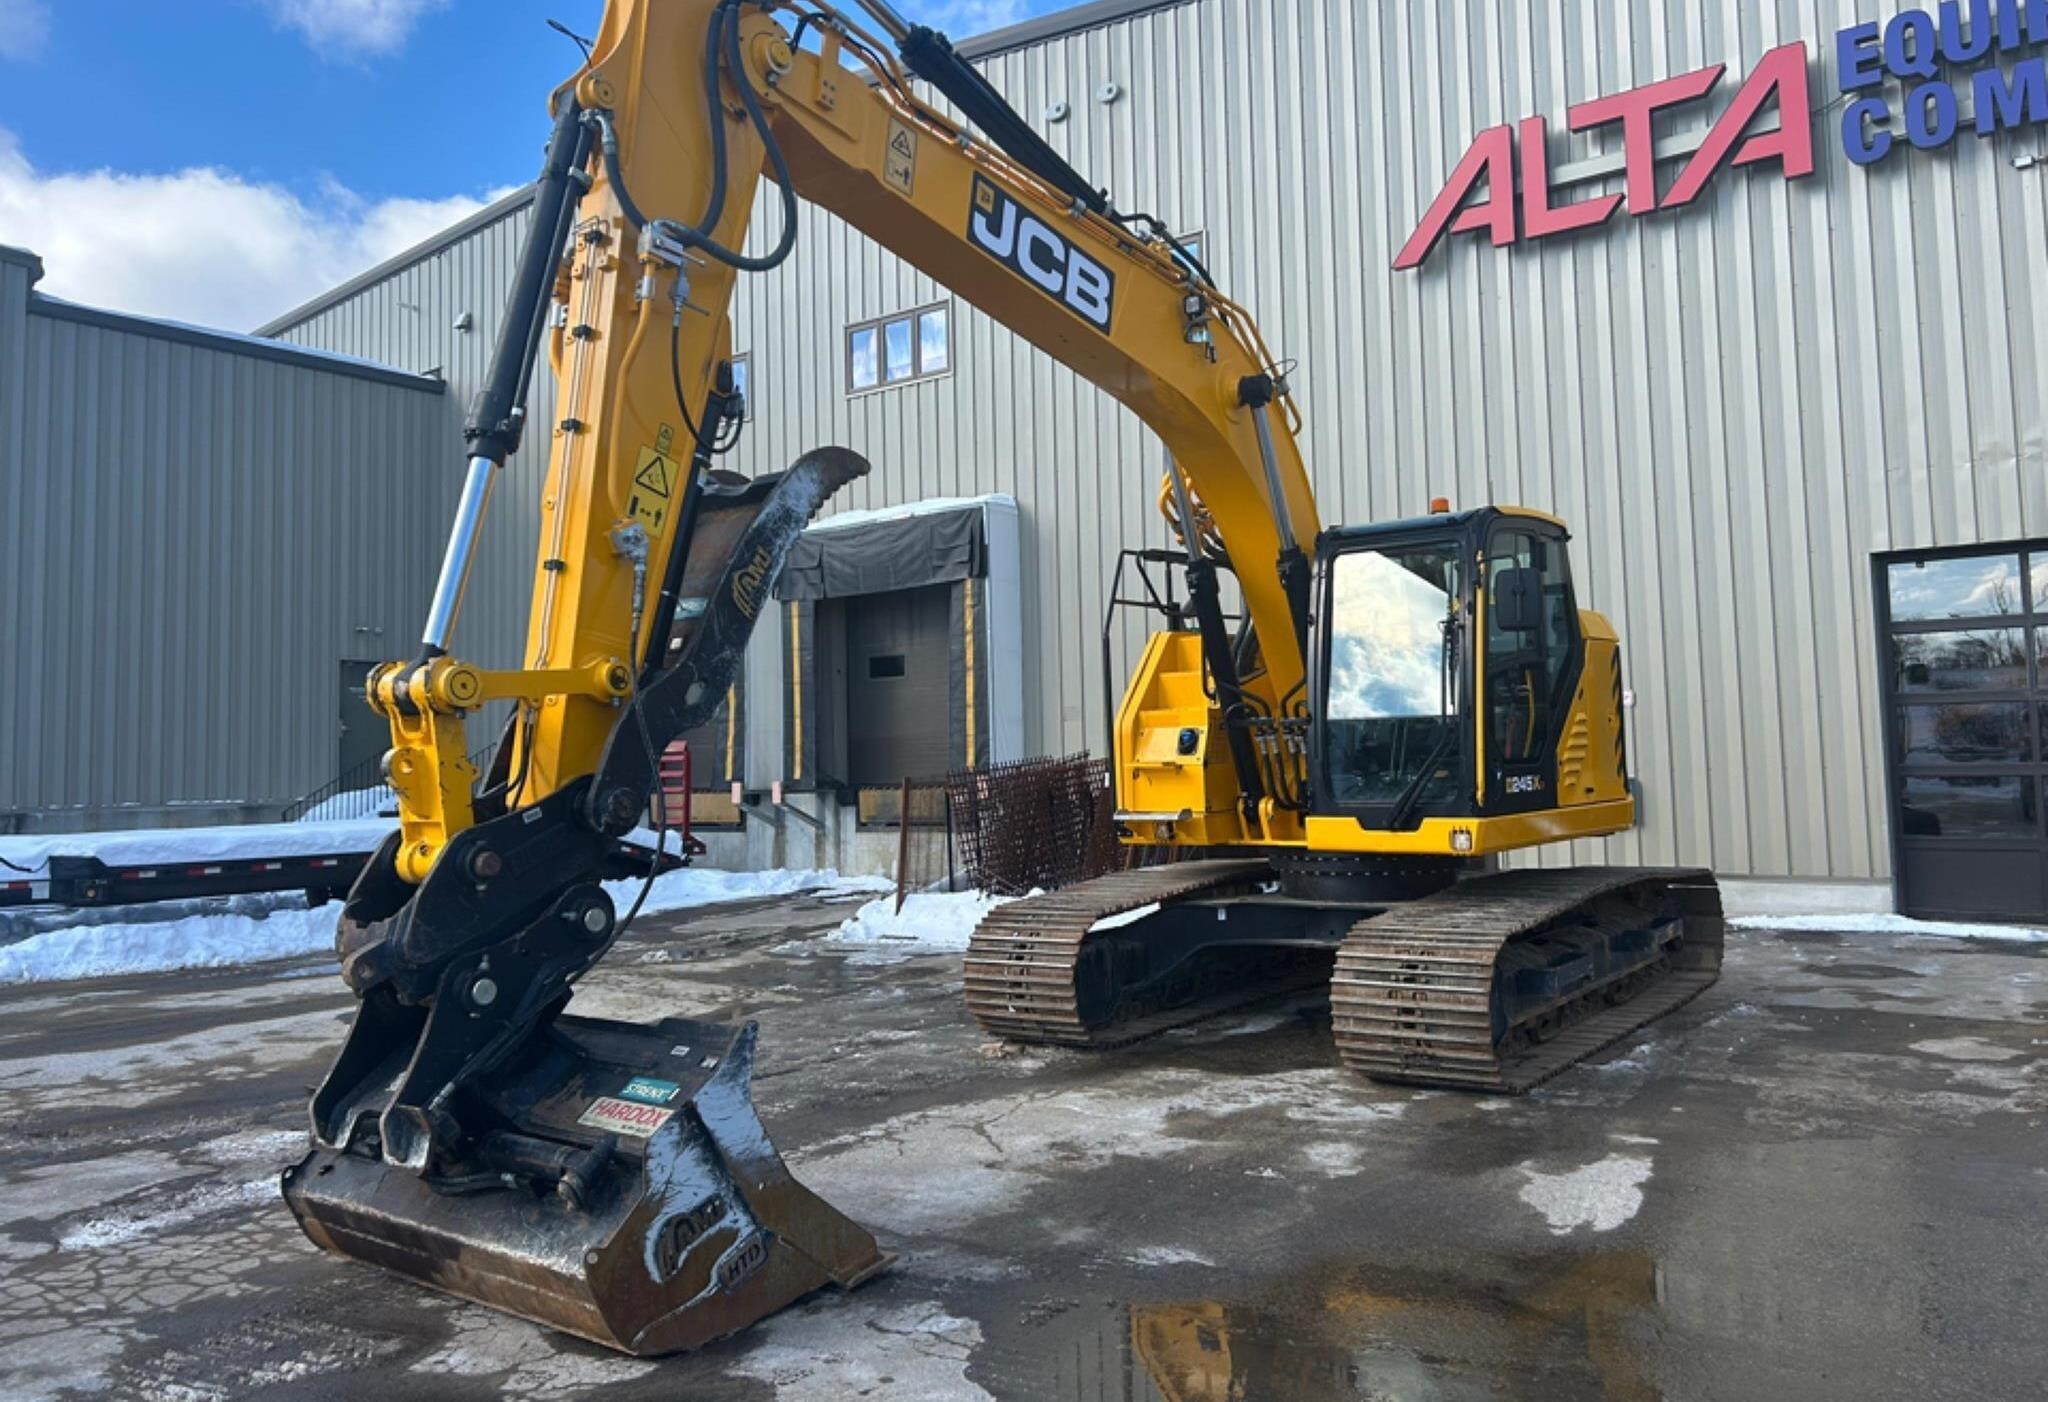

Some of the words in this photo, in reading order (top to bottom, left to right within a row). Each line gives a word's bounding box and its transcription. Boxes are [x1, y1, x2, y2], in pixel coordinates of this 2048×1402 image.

[1392, 41, 1814, 270] ALTA
[1841, 57, 2048, 166] COM
[973, 199, 1110, 325] JCB
[591, 1101, 670, 1127] HARDOX
